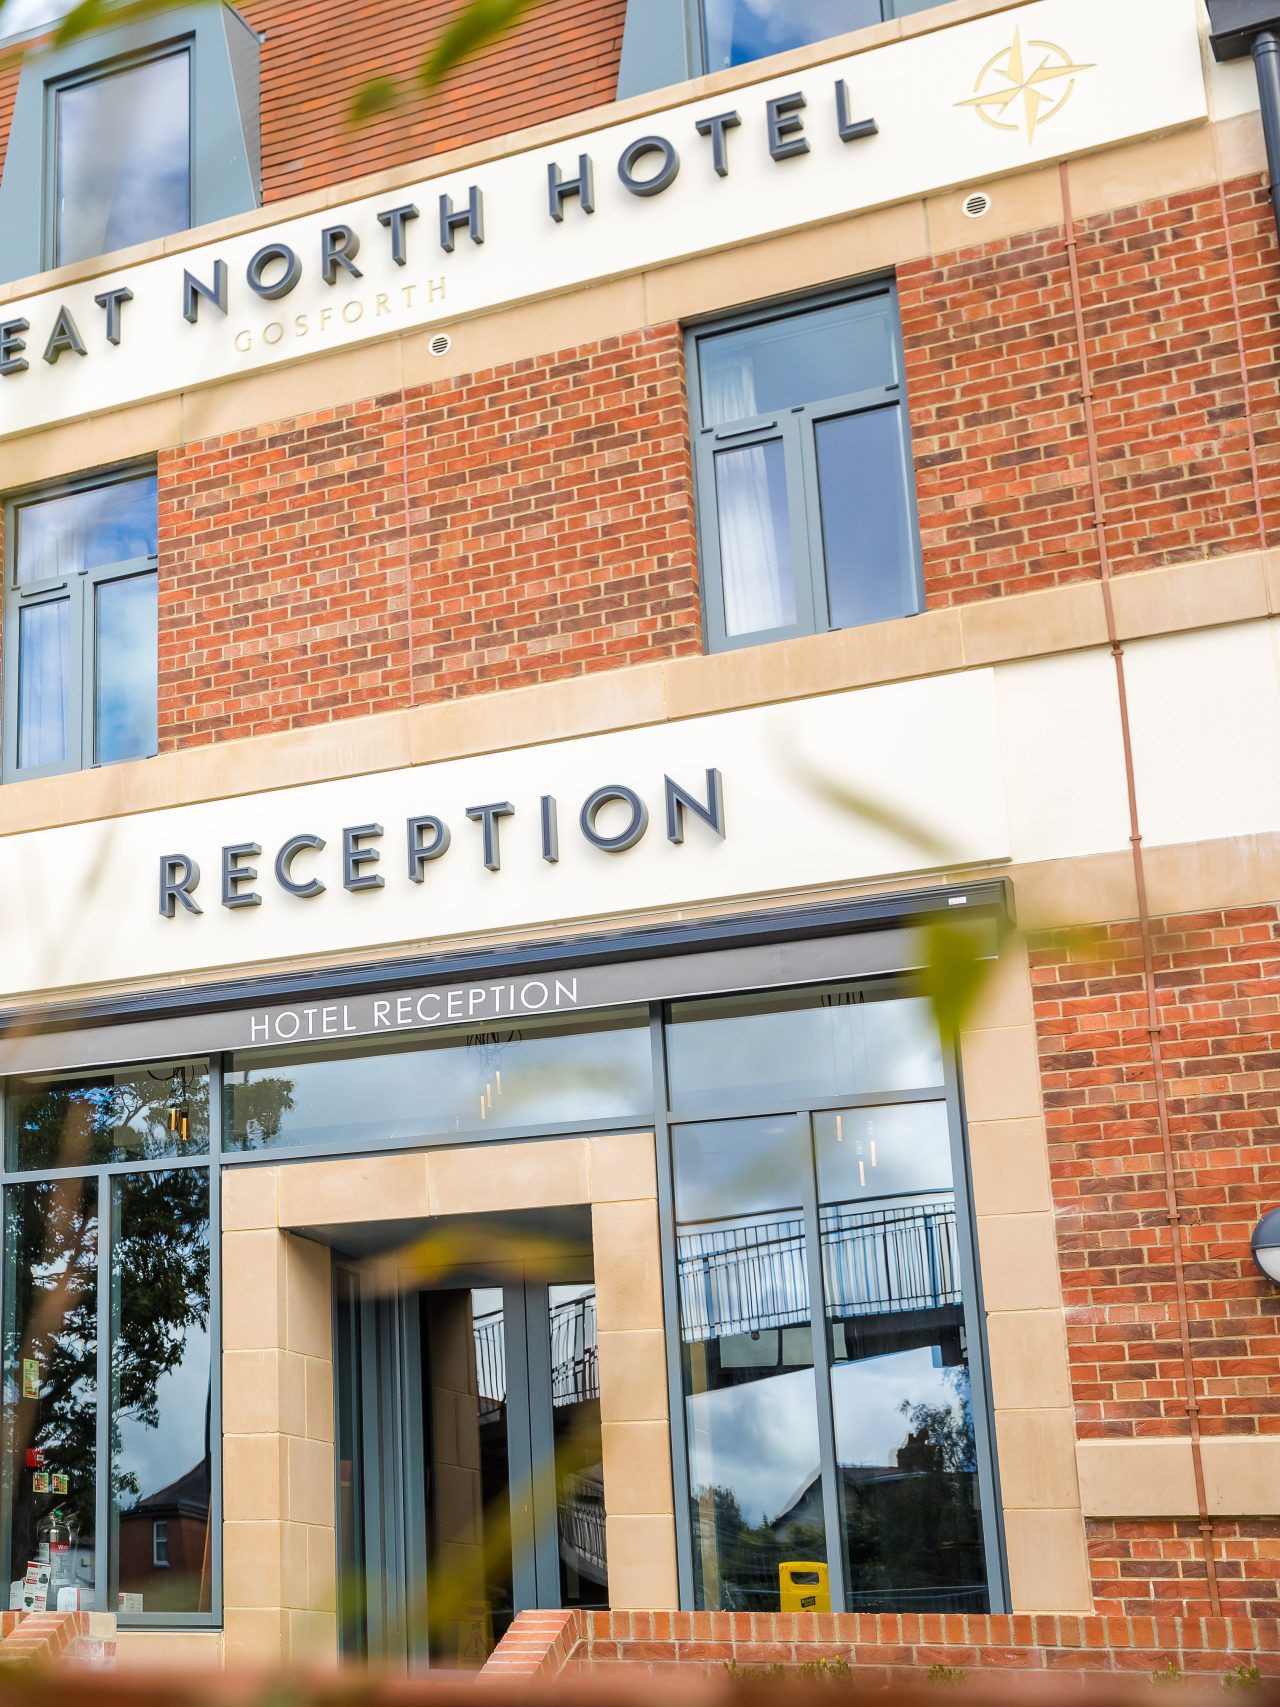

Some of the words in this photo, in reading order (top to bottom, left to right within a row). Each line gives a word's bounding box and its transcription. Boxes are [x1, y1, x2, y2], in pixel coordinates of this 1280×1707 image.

[183, 186, 485, 324] NORTH
[547, 79, 879, 223] HOTEL
[234, 276, 446, 352] GOSFORTH
[158, 767, 725, 919] RECEPTION
[250, 1003, 357, 1043] HOTEL
[373, 976, 580, 1028] RECEPTION
